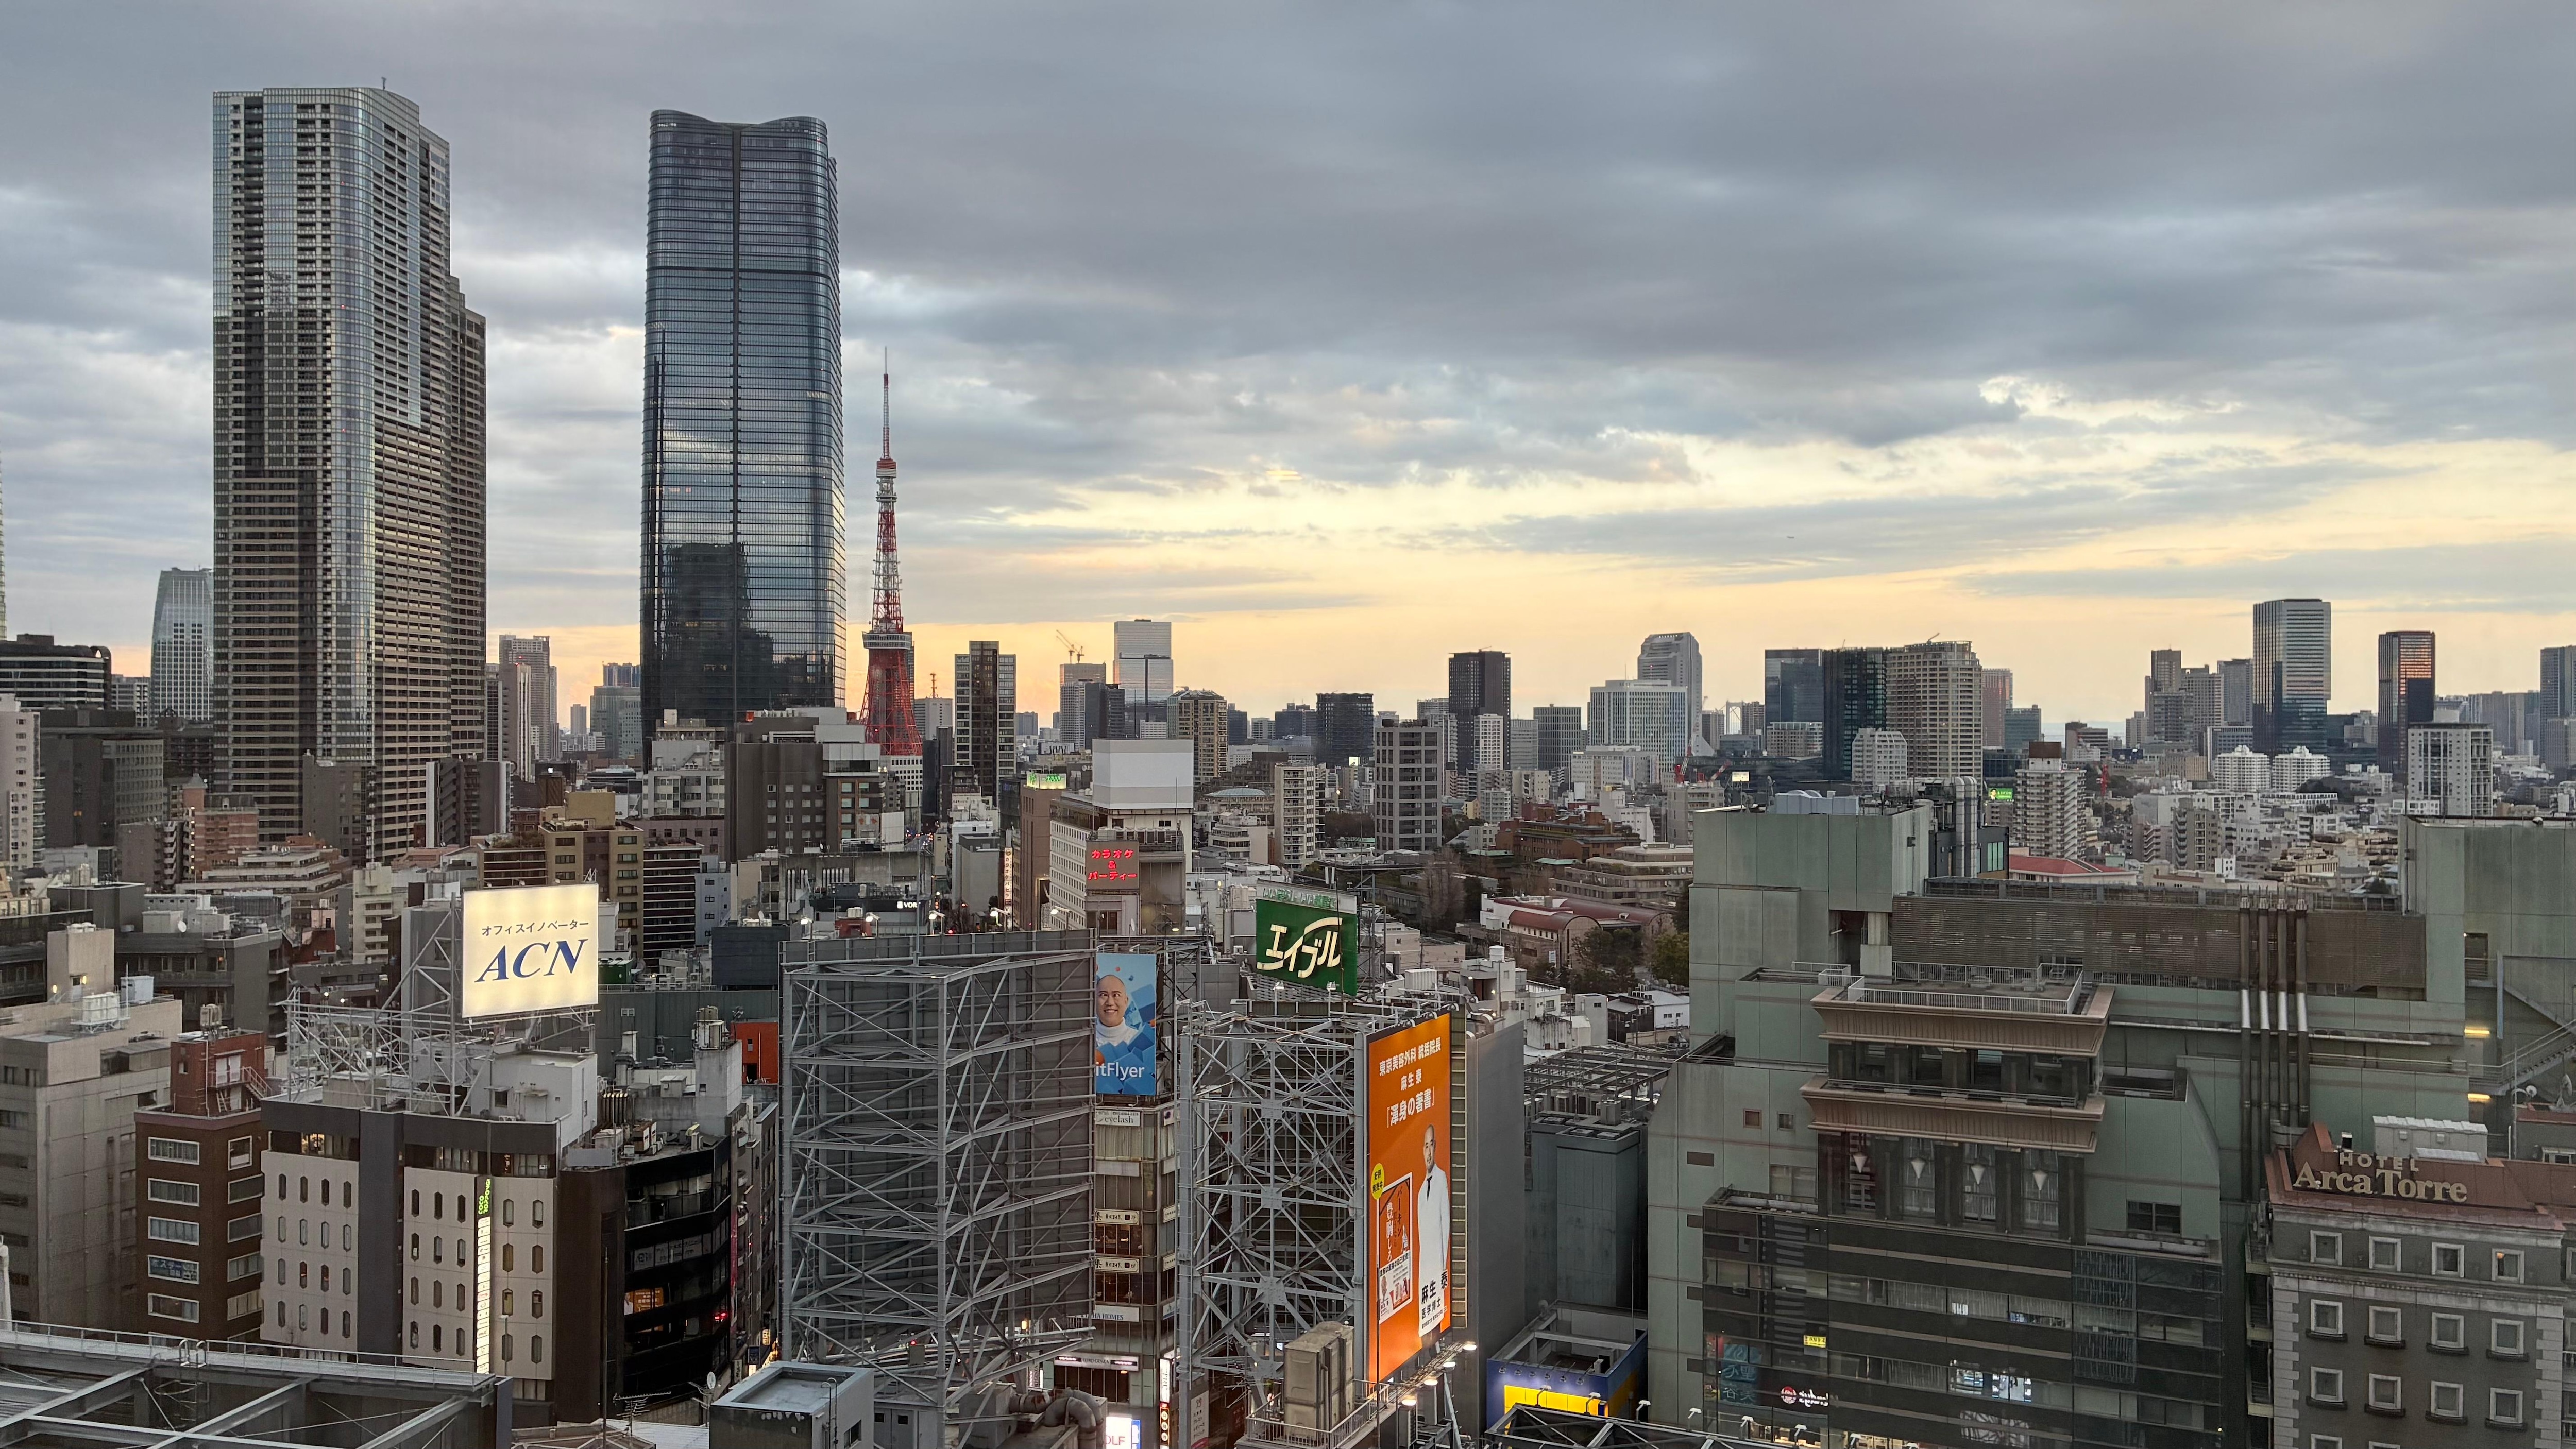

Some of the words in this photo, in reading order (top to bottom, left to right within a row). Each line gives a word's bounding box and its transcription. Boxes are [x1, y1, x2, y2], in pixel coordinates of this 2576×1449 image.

[1092, 849, 1133, 859] カラオケ
[1108, 860, 1116, 869] &
[1088, 871, 1137, 880] パーティー
[482, 919, 589, 936] オフィスイノベーター
[1257, 917, 1343, 978] エイブル
[474, 939, 588, 983] ACN
[1379, 1047, 1416, 1076] 東京美容外科
[1401, 1072, 1414, 1091] 麻生
[1105, 1115, 1133, 1123] eyelash
[2340, 1152, 2419, 1172] HOTEL
[2293, 1161, 2373, 1194] Arca
[2376, 1169, 2468, 1203] Torre
[1421, 1279, 1436, 1304] 麻生
[1421, 1297, 1441, 1320] 医学博士
